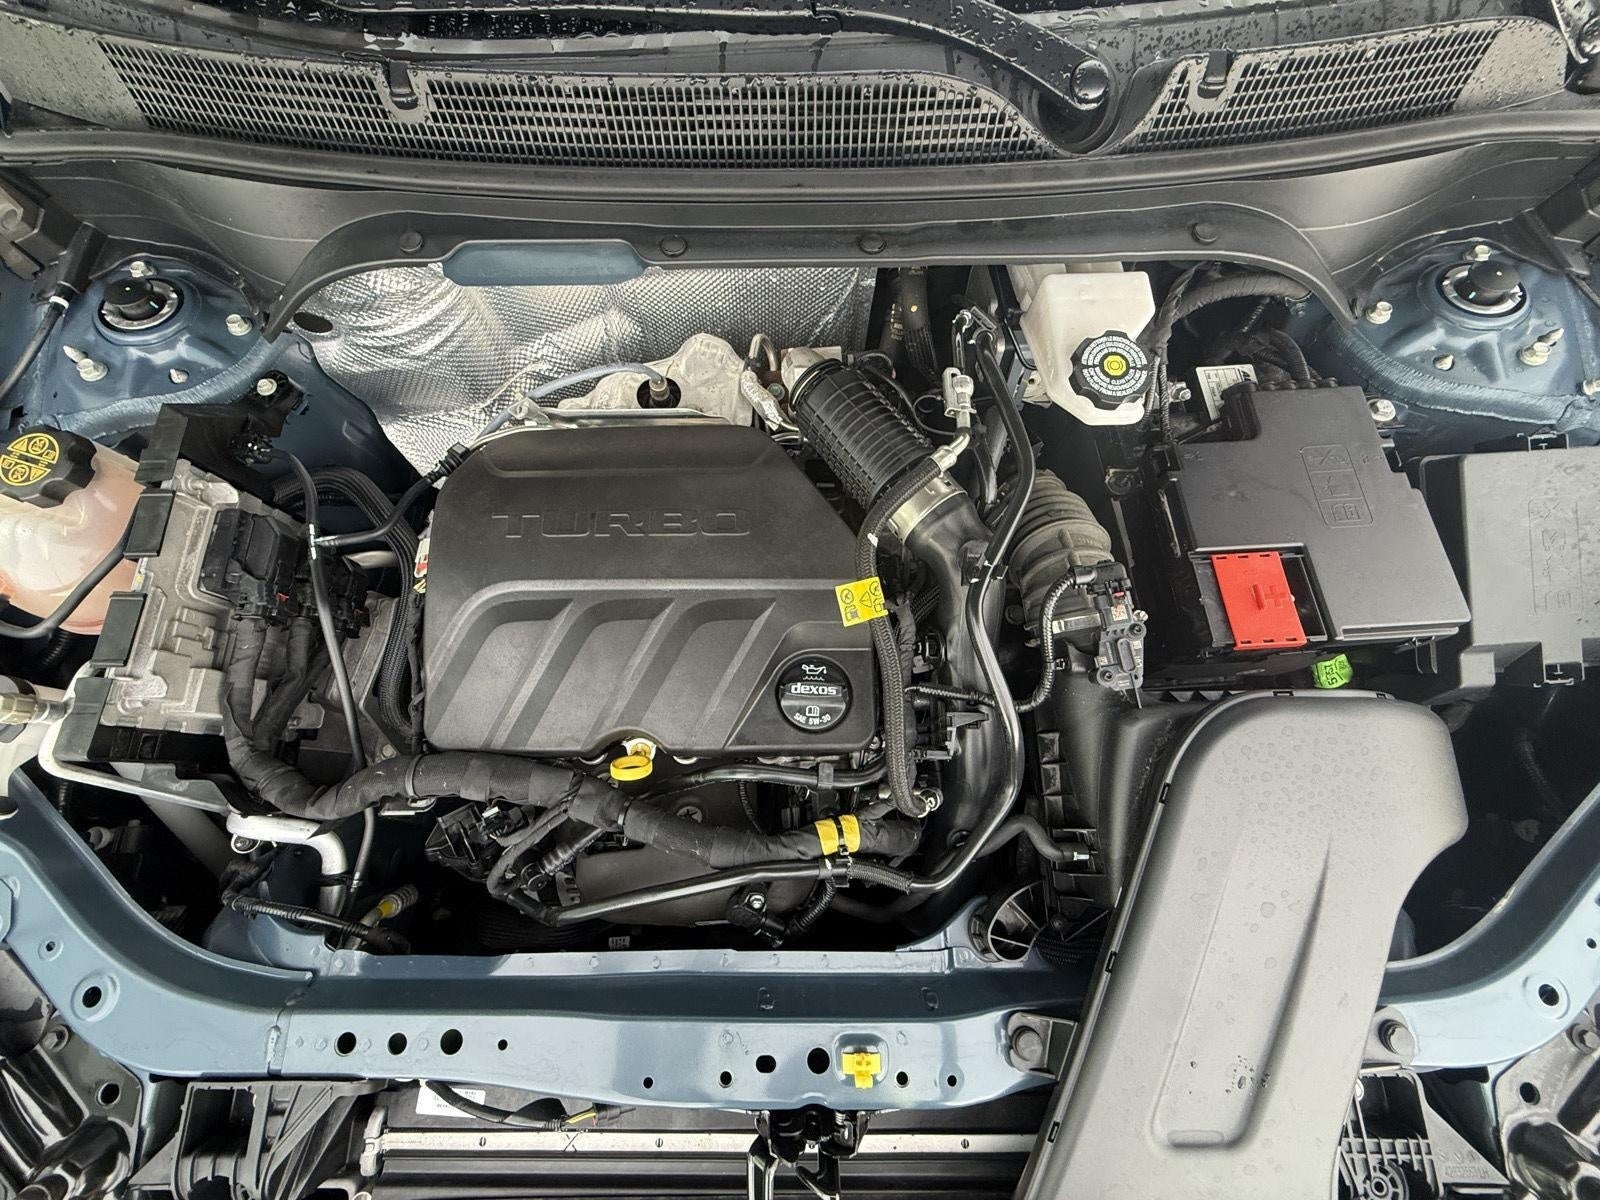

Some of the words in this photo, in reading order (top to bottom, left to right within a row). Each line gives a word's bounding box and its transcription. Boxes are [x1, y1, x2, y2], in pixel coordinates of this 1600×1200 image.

[491, 509, 750, 538] TURBO
[790, 682, 837, 695] dexos
[793, 712, 807, 724] SAE
[808, 714, 832, 725] 5W-30
